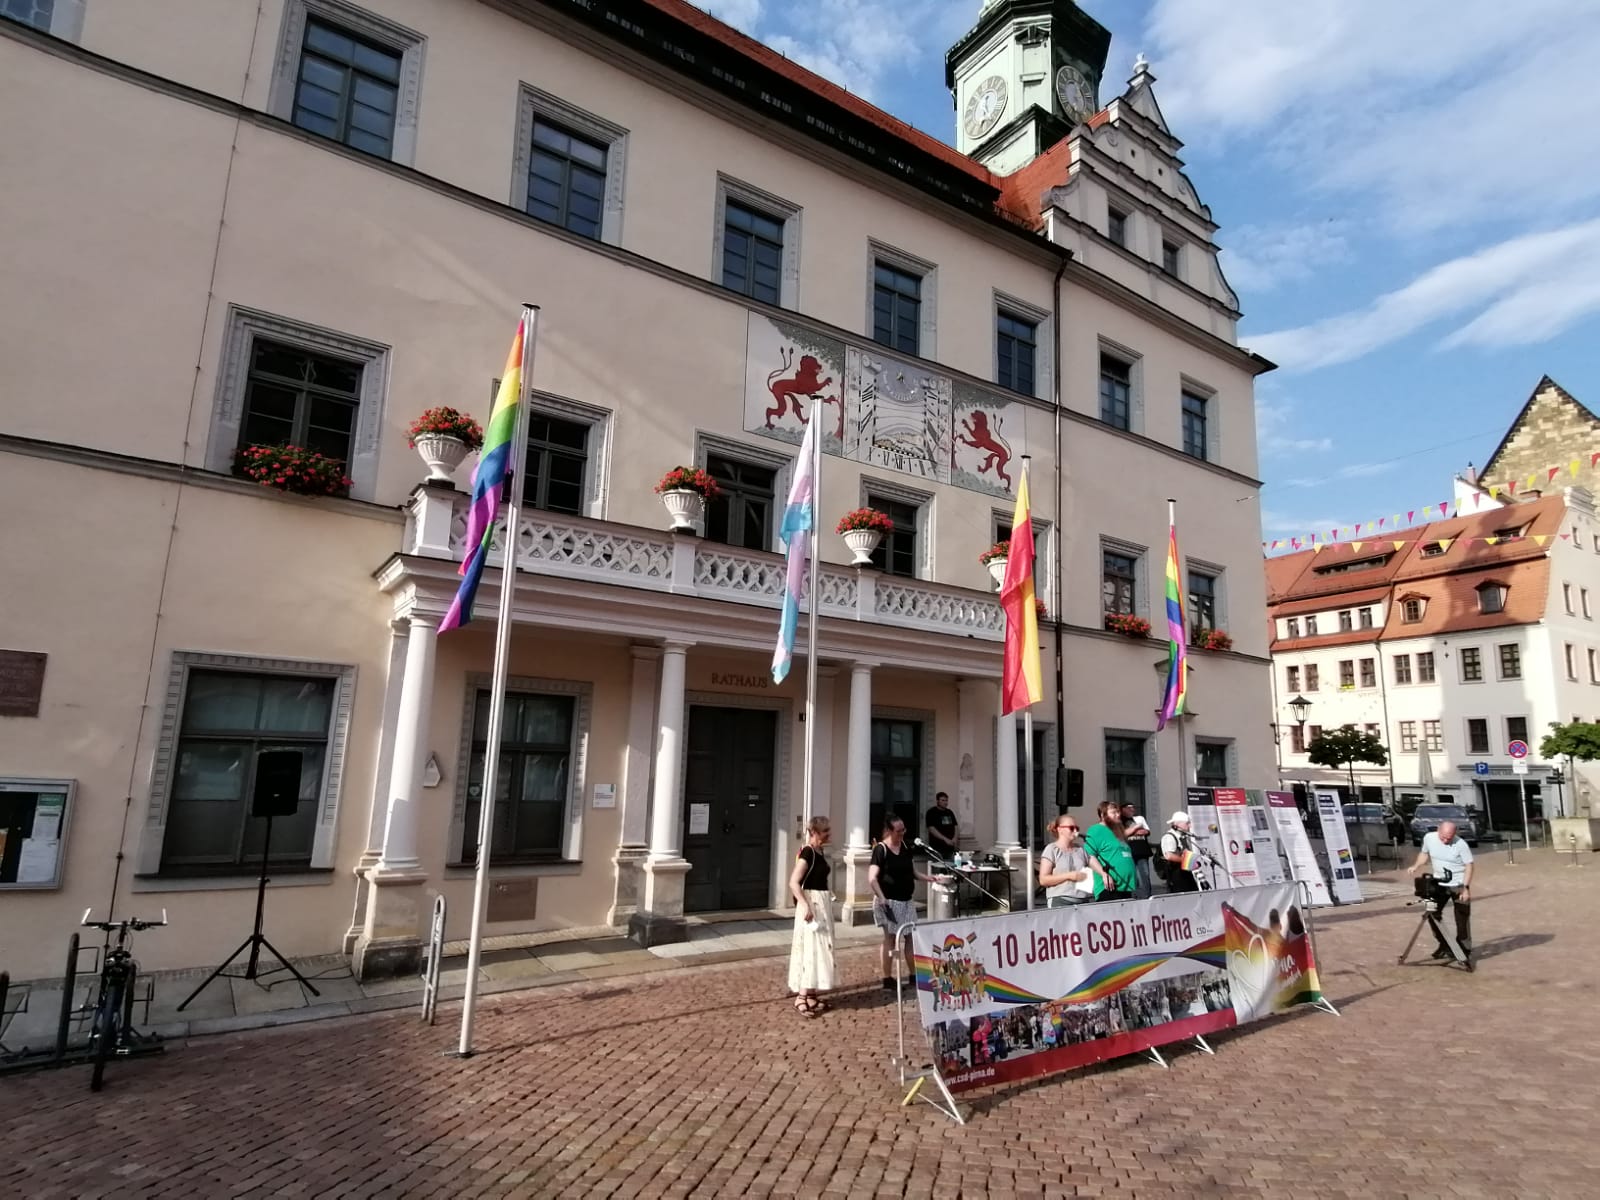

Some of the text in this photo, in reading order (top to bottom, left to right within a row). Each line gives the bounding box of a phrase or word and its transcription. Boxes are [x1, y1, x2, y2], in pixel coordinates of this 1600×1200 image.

[711, 673, 768, 688] RATHAUS
[992, 914, 1193, 969] 10 Jahre CSD in Pirna
